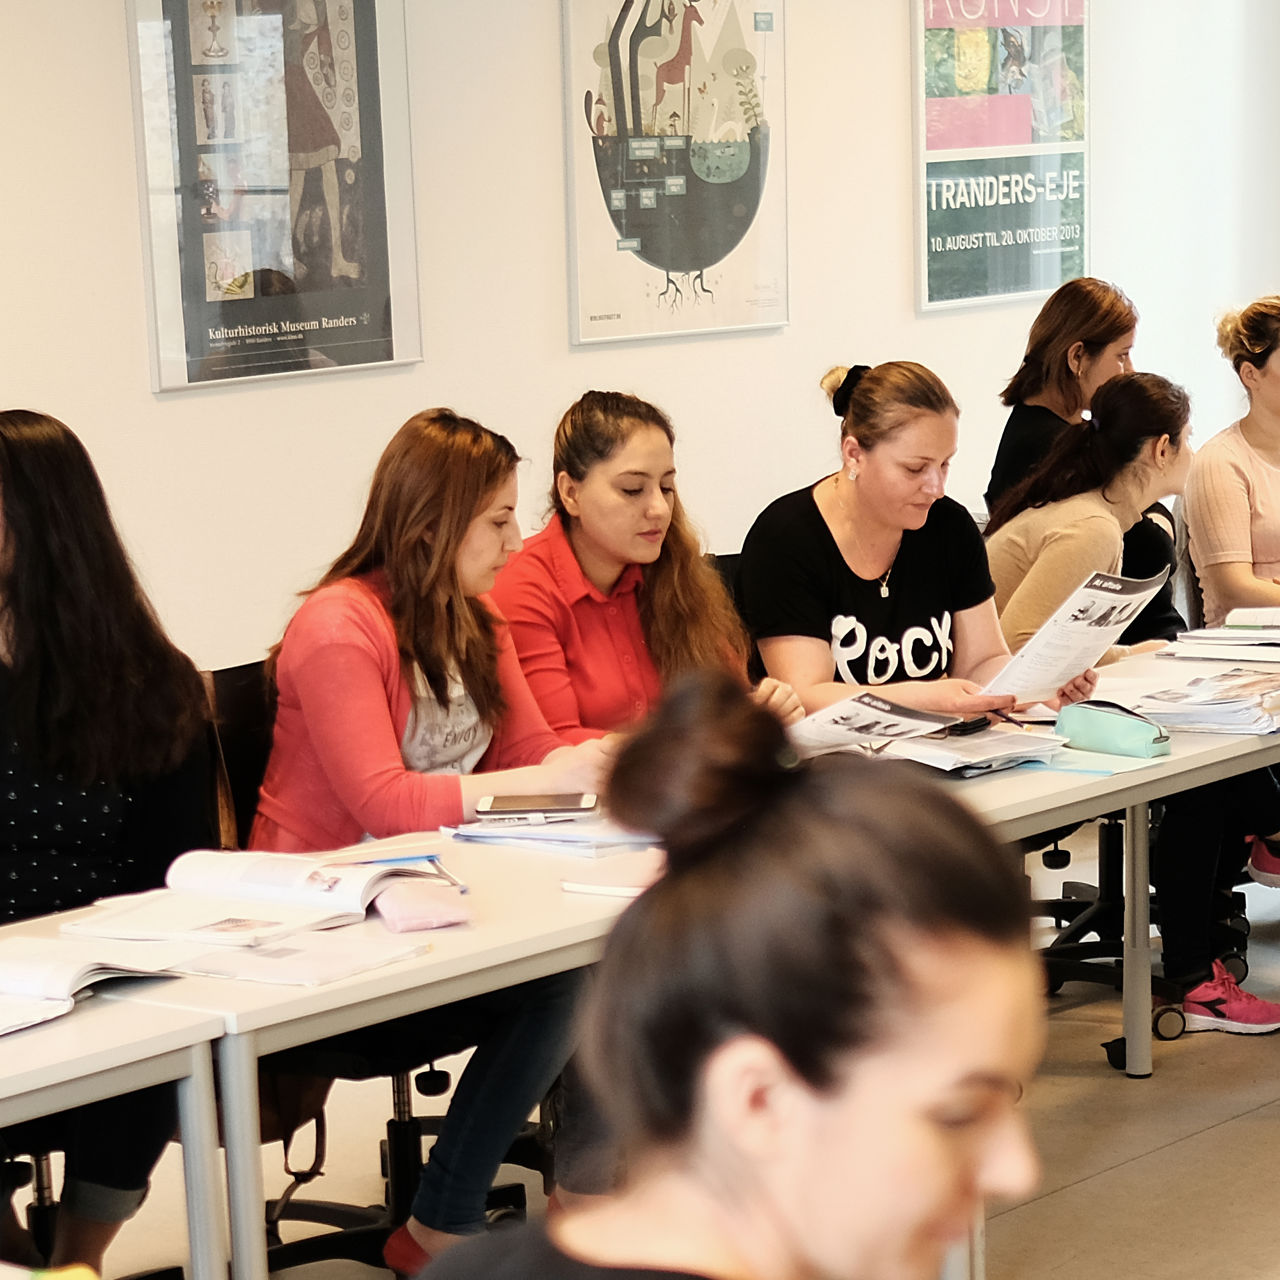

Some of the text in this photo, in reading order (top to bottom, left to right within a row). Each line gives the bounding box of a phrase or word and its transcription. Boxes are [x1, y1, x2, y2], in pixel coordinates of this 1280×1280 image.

[930, 170, 1080, 210] I RANDERS-EJE
[931, 225, 1080, 252] 10. AUGUST TIL 20. OKTOBER 2013
[208, 315, 357, 340] Kulturhistorisk Museum Randers
